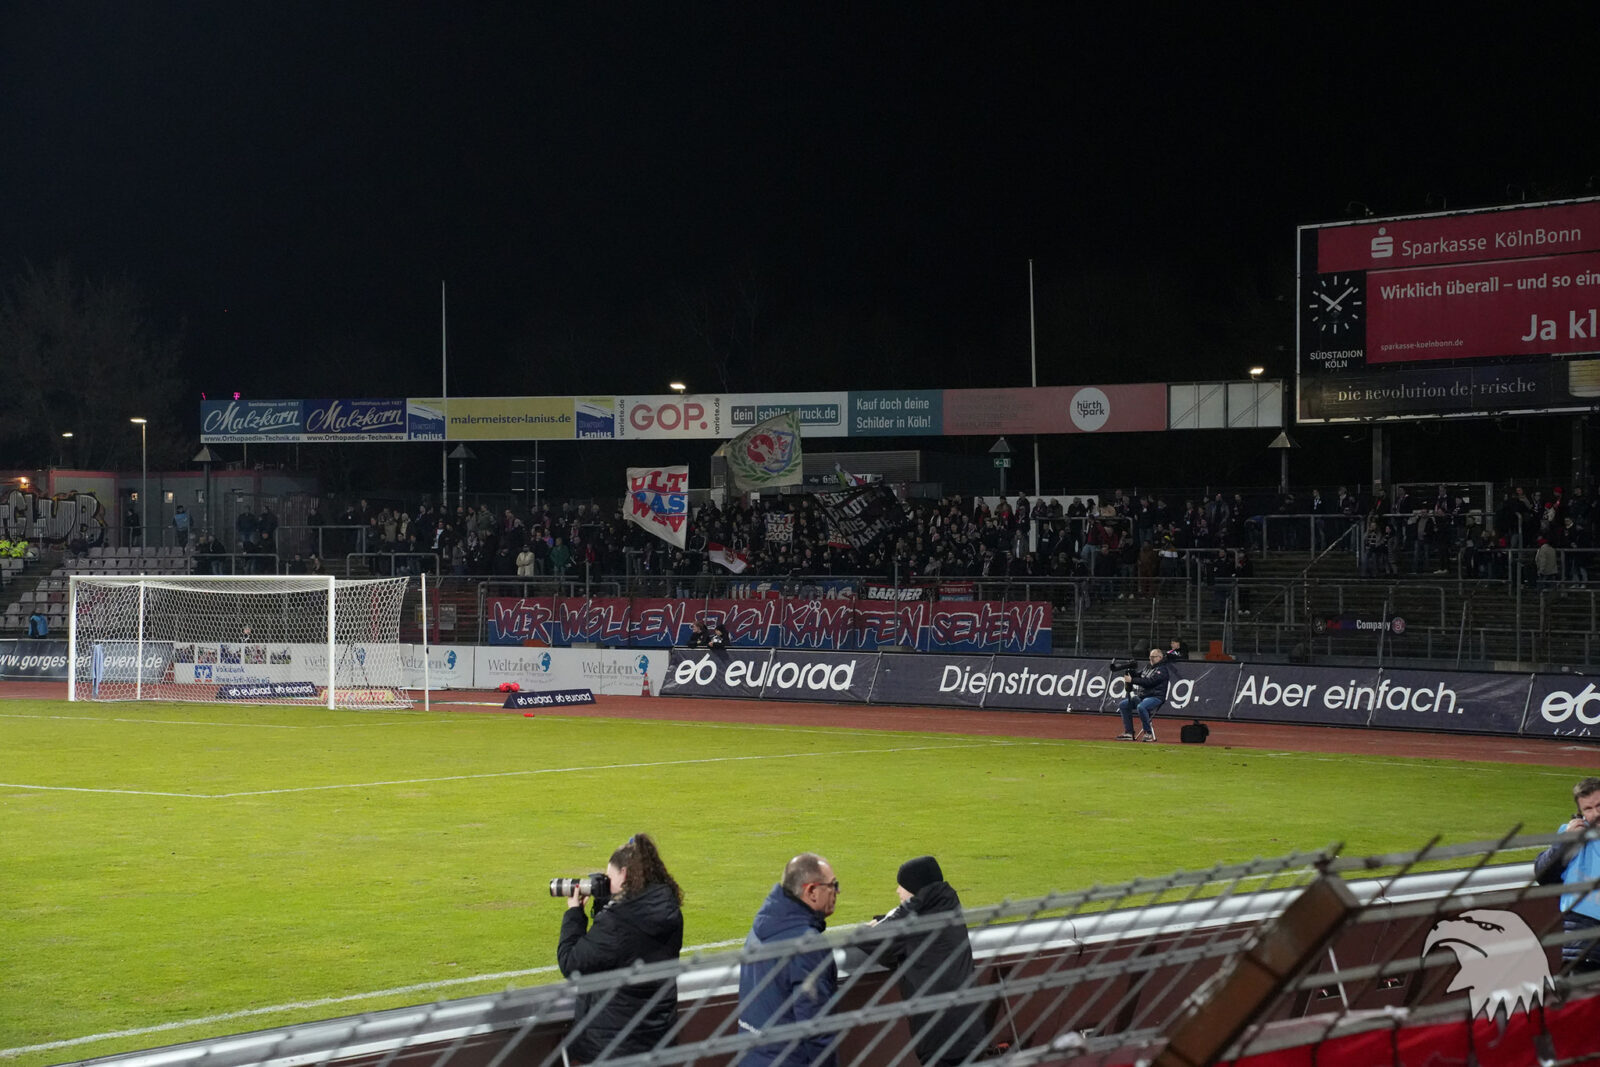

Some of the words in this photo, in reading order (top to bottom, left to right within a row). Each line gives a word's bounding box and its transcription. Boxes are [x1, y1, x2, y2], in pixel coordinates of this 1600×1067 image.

[1401, 237, 1487, 259] Sparkasse
[1495, 228, 1581, 248] KölnBonn
[1380, 281, 1442, 299] Wirklich
[1446, 277, 1500, 295] überall
[1517, 272, 1547, 290] und
[1551, 275, 1571, 288] so
[1521, 314, 1557, 342] Ja
[1380, 339, 1464, 352] sparkasse-koelnbonn.de
[1310, 349, 1363, 361] SÜDSTADION
[1325, 359, 1348, 369] KÖLN
[1338, 385, 1361, 402] Die
[1365, 381, 1446, 401] Revolution
[1450, 380, 1477, 397] der
[1481, 377, 1537, 395] Frische
[856, 398, 878, 411] Kauf
[879, 397, 903, 410] doch
[904, 397, 930, 409] deine
[1076, 400, 1102, 412] hürth
[204, 401, 300, 432] Malzkorn
[306, 400, 403, 432] Malzkorn
[450, 414, 571, 424] malermeister-lanius.de
[629, 403, 708, 431] GOP.
[733, 408, 754, 421] dein
[1082, 406, 1105, 418] park
[856, 416, 894, 430] Schilder
[896, 416, 906, 428] in
[907, 415, 931, 428] Köln!
[204, 434, 300, 442] www.Orthopaedie-Technik.eu
[307, 433, 404, 441] www.Orthopaedie-Technik.eu
[632, 471, 688, 492] ULT
[867, 587, 923, 601] BARMER
[494, 599, 552, 645] WIR
[559, 599, 686, 645] WOLLEN
[784, 600, 924, 650] KÄMPFEN
[932, 602, 1044, 652] SEHEN!
[488, 657, 540, 671] Weltzien
[582, 660, 633, 674] Weltzien
[724, 659, 857, 691] eurorad
[527, 694, 554, 705] eurorad
[565, 692, 592, 702] eurorad
[1235, 675, 1317, 707] Aber
[1323, 679, 1464, 714] einfach.
